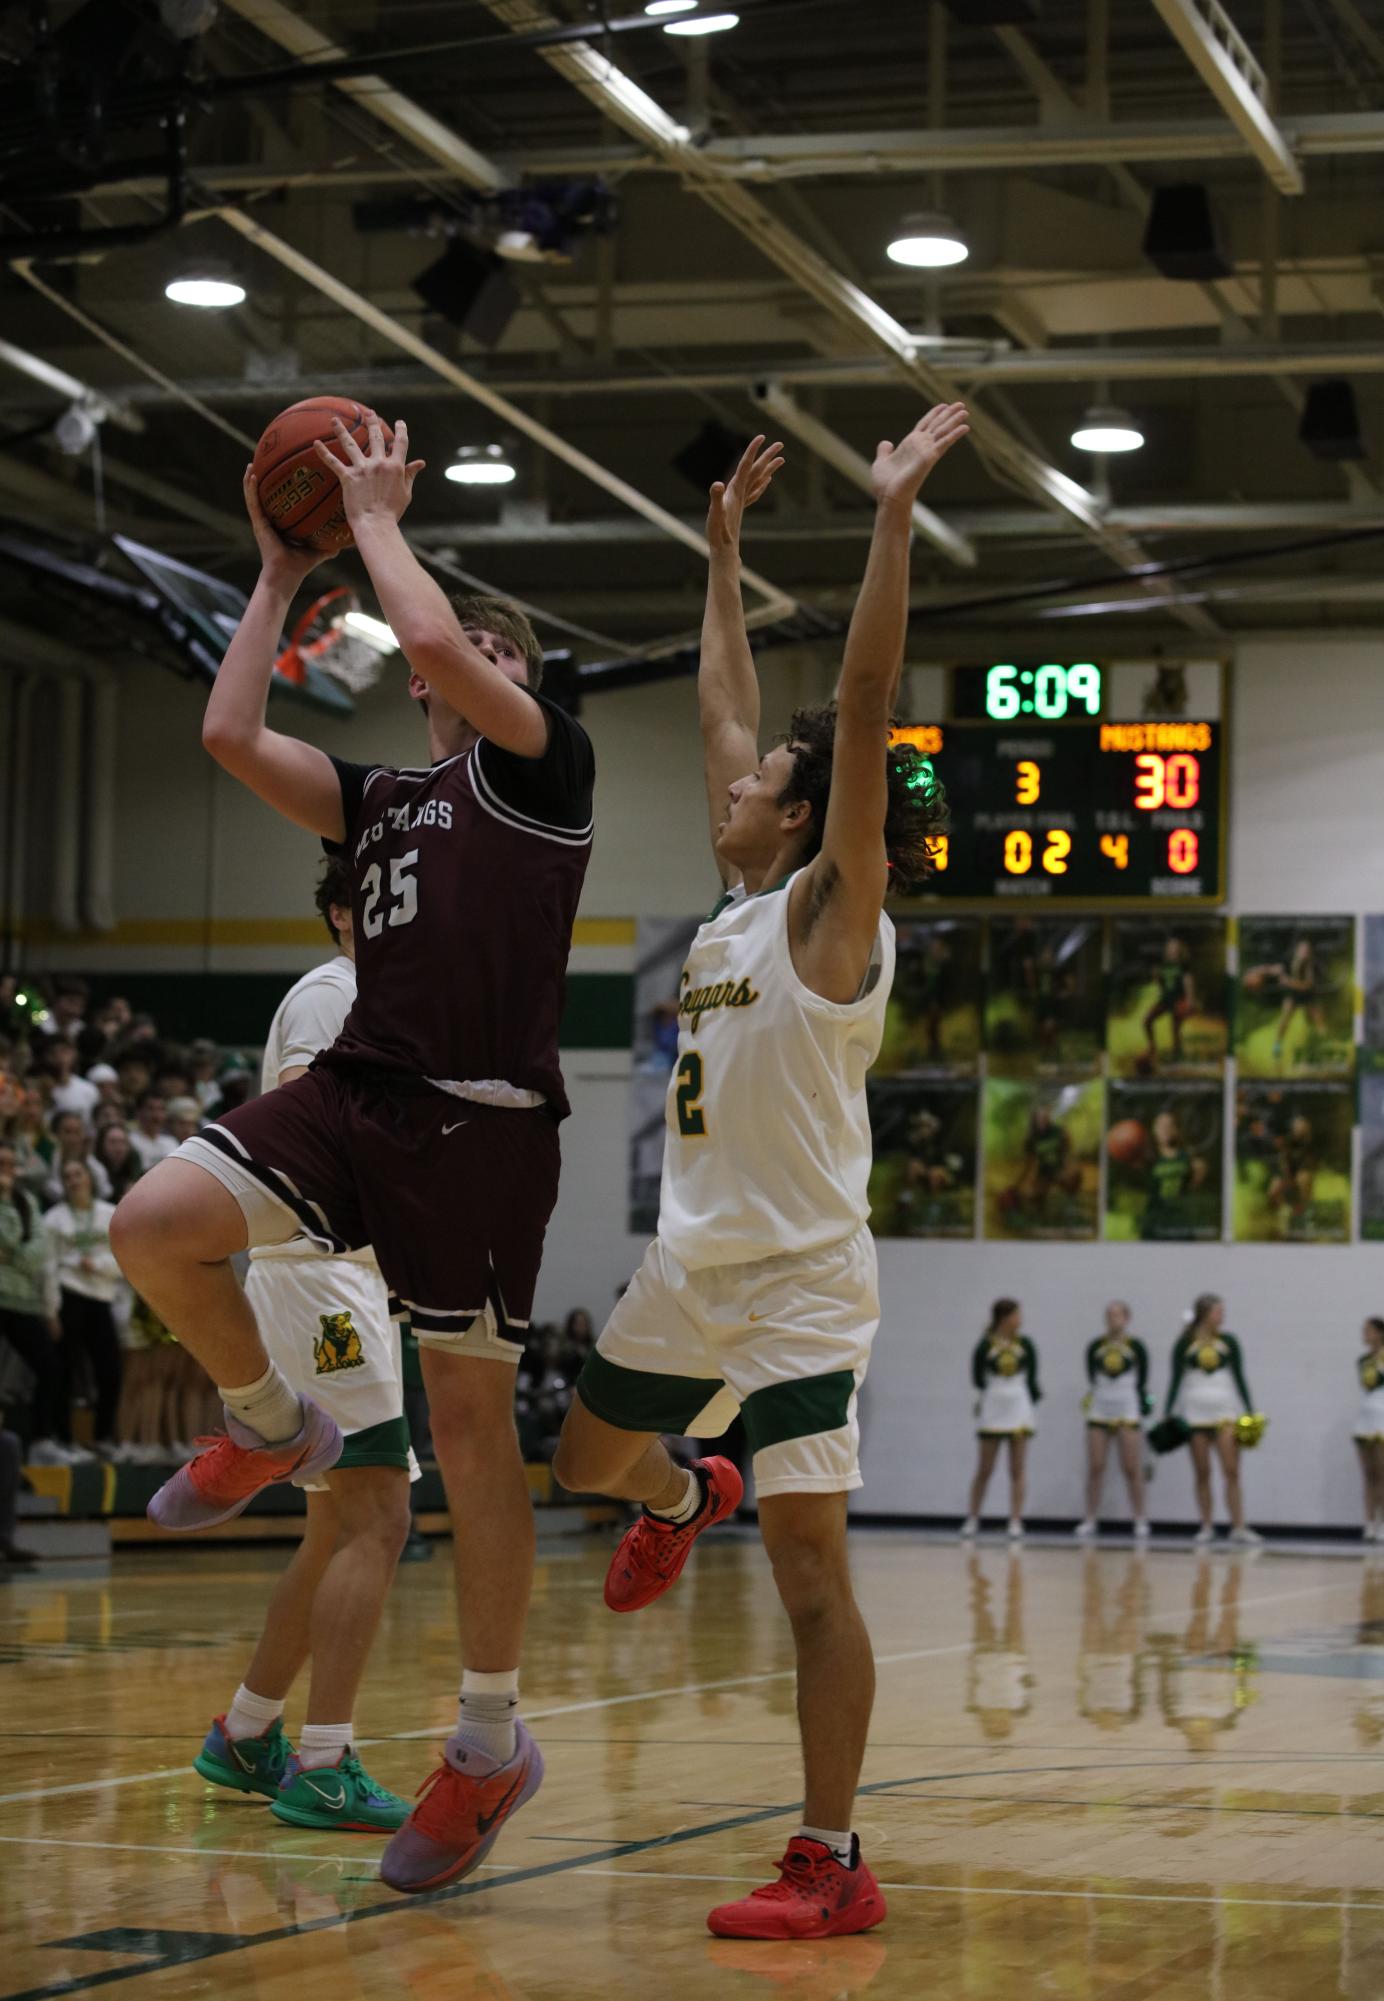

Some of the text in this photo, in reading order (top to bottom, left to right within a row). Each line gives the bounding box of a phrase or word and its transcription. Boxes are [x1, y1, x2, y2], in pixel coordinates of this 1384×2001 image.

[270, 470, 326, 520] LEGAC
[986, 664, 1101, 720] 6:09
[1015, 760, 1041, 805] 3
[1134, 753, 1200, 810] 30
[1100, 833, 1129, 870] 4
[1167, 828, 1199, 874] 0
[360, 848, 419, 940] 25
[676, 1050, 709, 1138] 2
